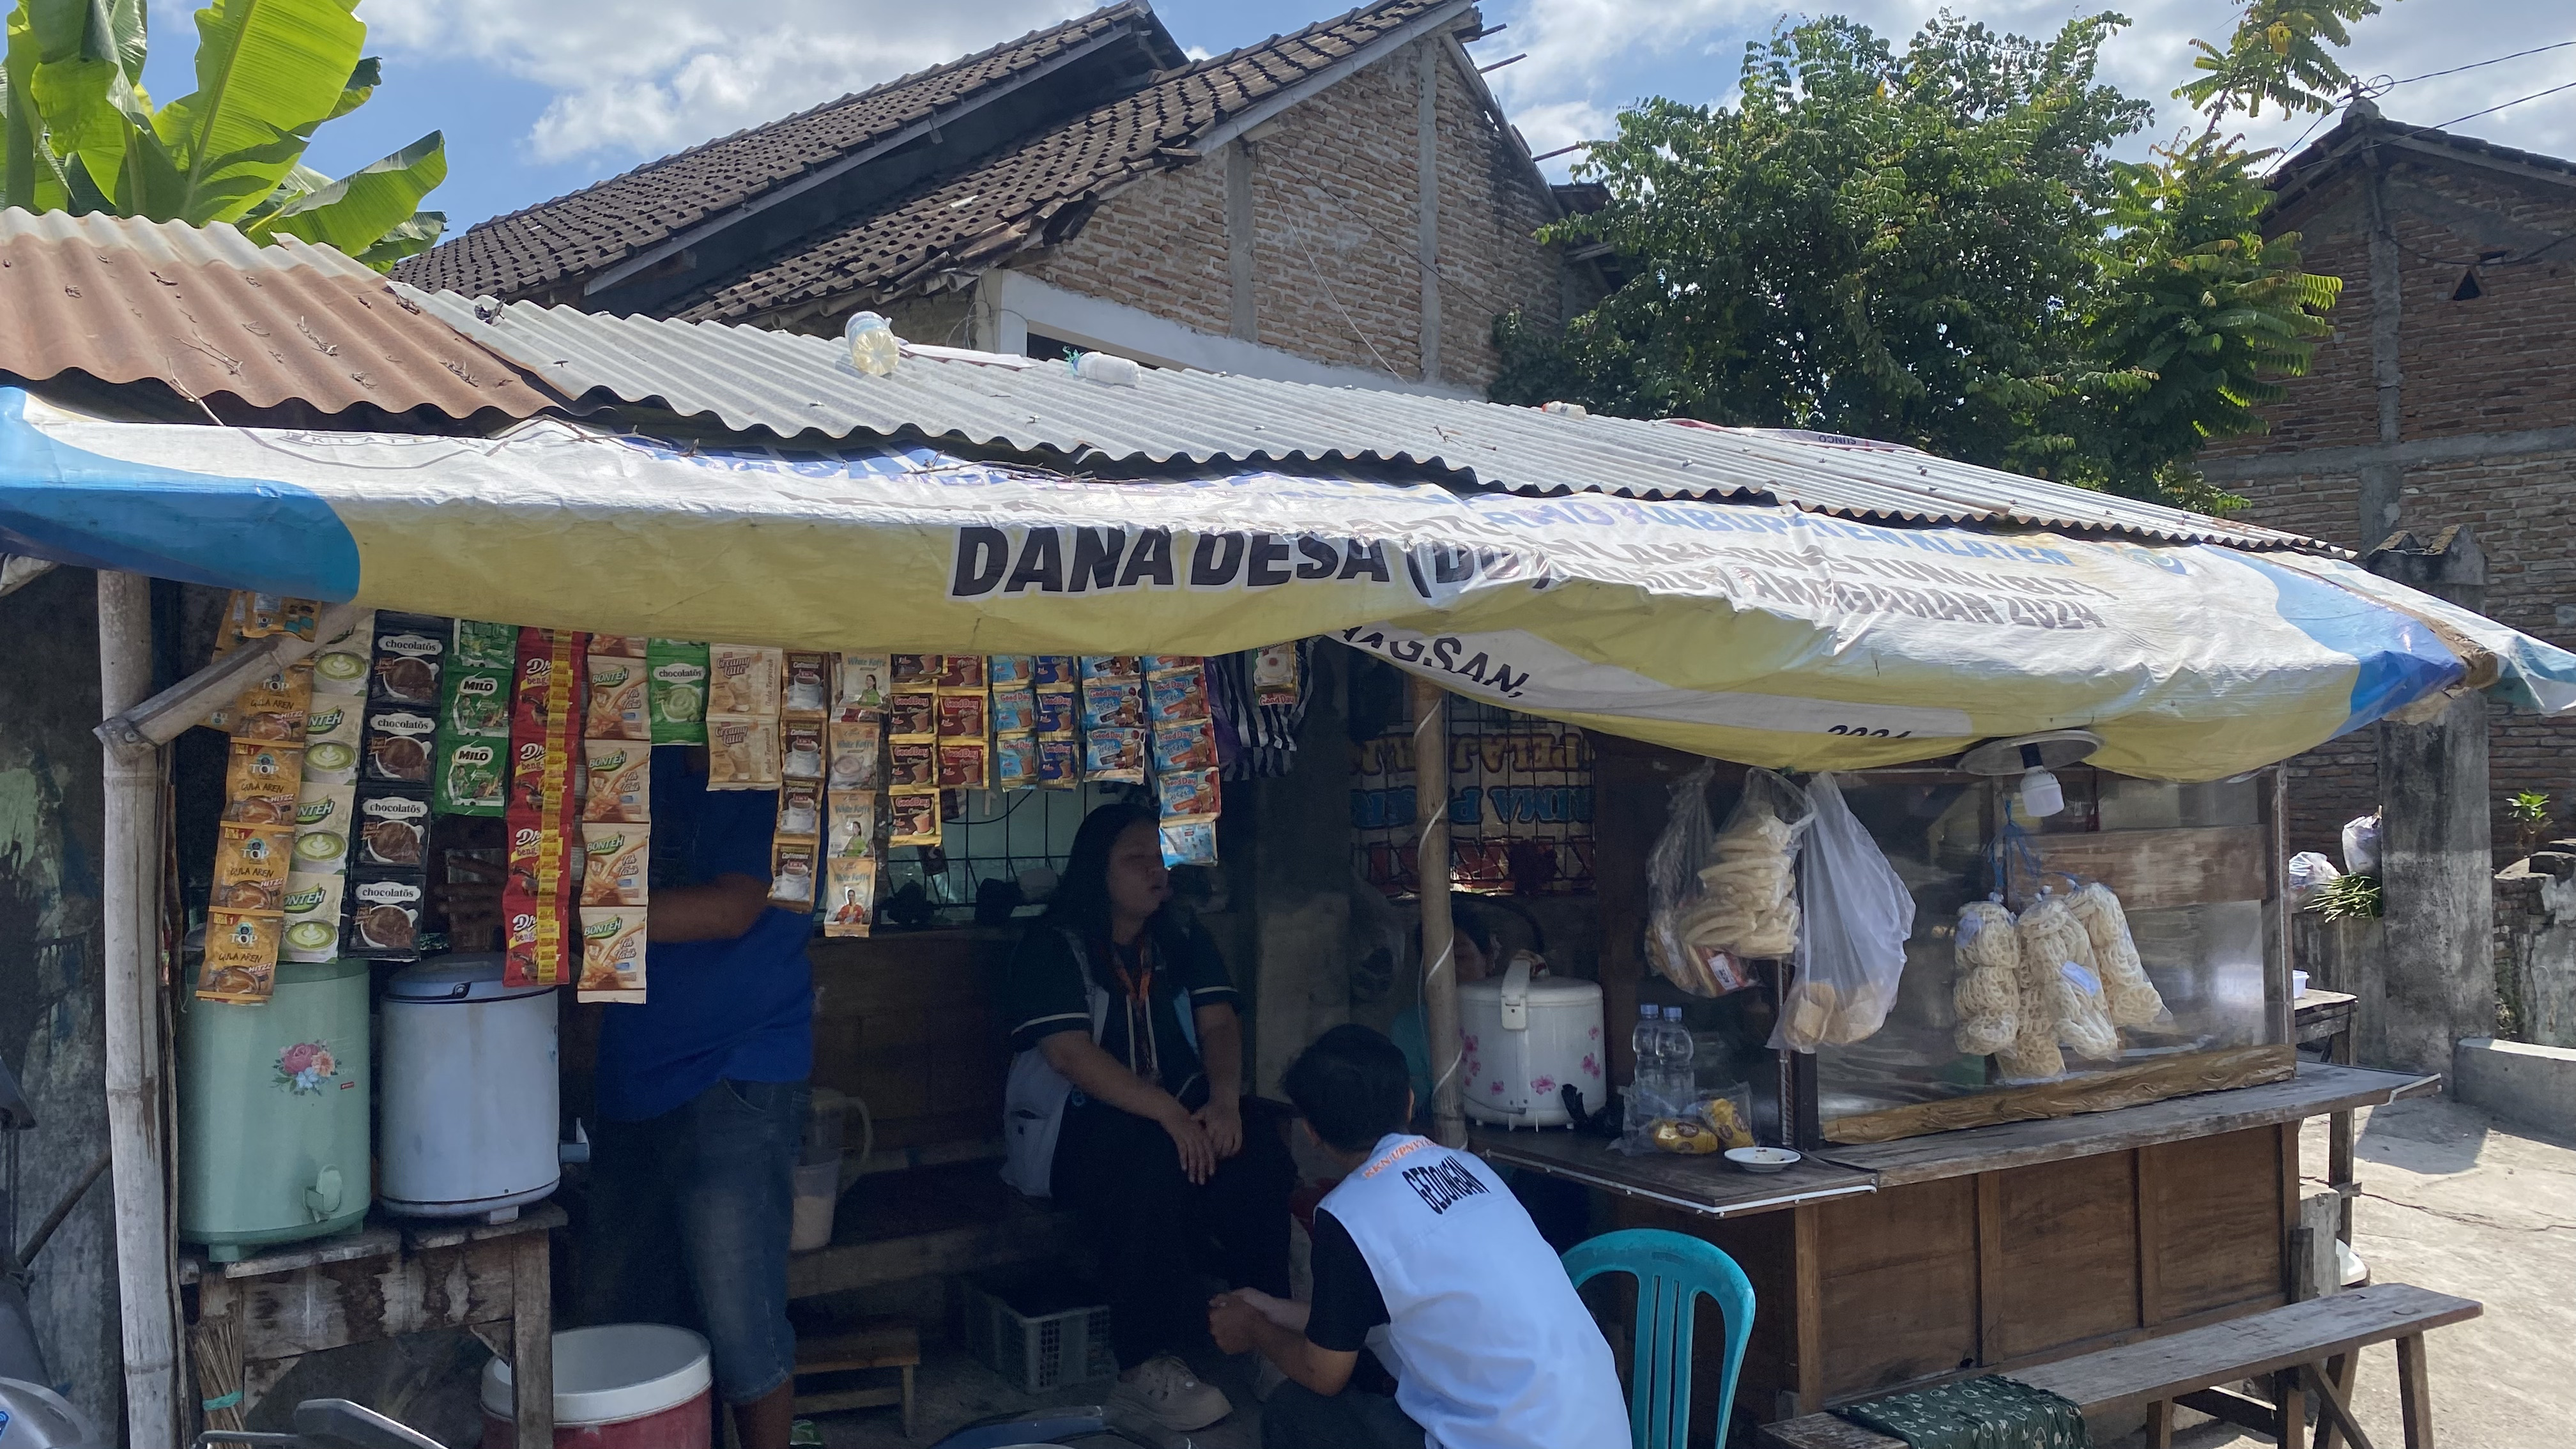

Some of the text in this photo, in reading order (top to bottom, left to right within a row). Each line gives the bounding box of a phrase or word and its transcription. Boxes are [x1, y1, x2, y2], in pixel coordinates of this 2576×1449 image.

[1819, 435, 1856, 445] SUNCO
[1902, 532, 2076, 567] KLATEN
[952, 525, 1174, 596] DANA
[1189, 530, 1391, 587] DESA
[1988, 594, 2106, 629] 2024
[1844, 555, 2004, 591] TUNAI
[592, 670, 629, 684] BONTEH
[464, 680, 494, 692] MILO
[458, 750, 488, 760] MILO
[588, 753, 627, 768] BONTEH
[249, 764, 280, 774] TOP
[586, 834, 625, 852] BONTEH
[240, 848, 270, 859] TOP
[284, 889, 326, 906] ONTEH
[584, 919, 623, 937] BONTEH
[229, 933, 258, 945] TOP
[249, 962, 272, 972] HITZZ
[1402, 1155, 1491, 1215] GEDONGAN
